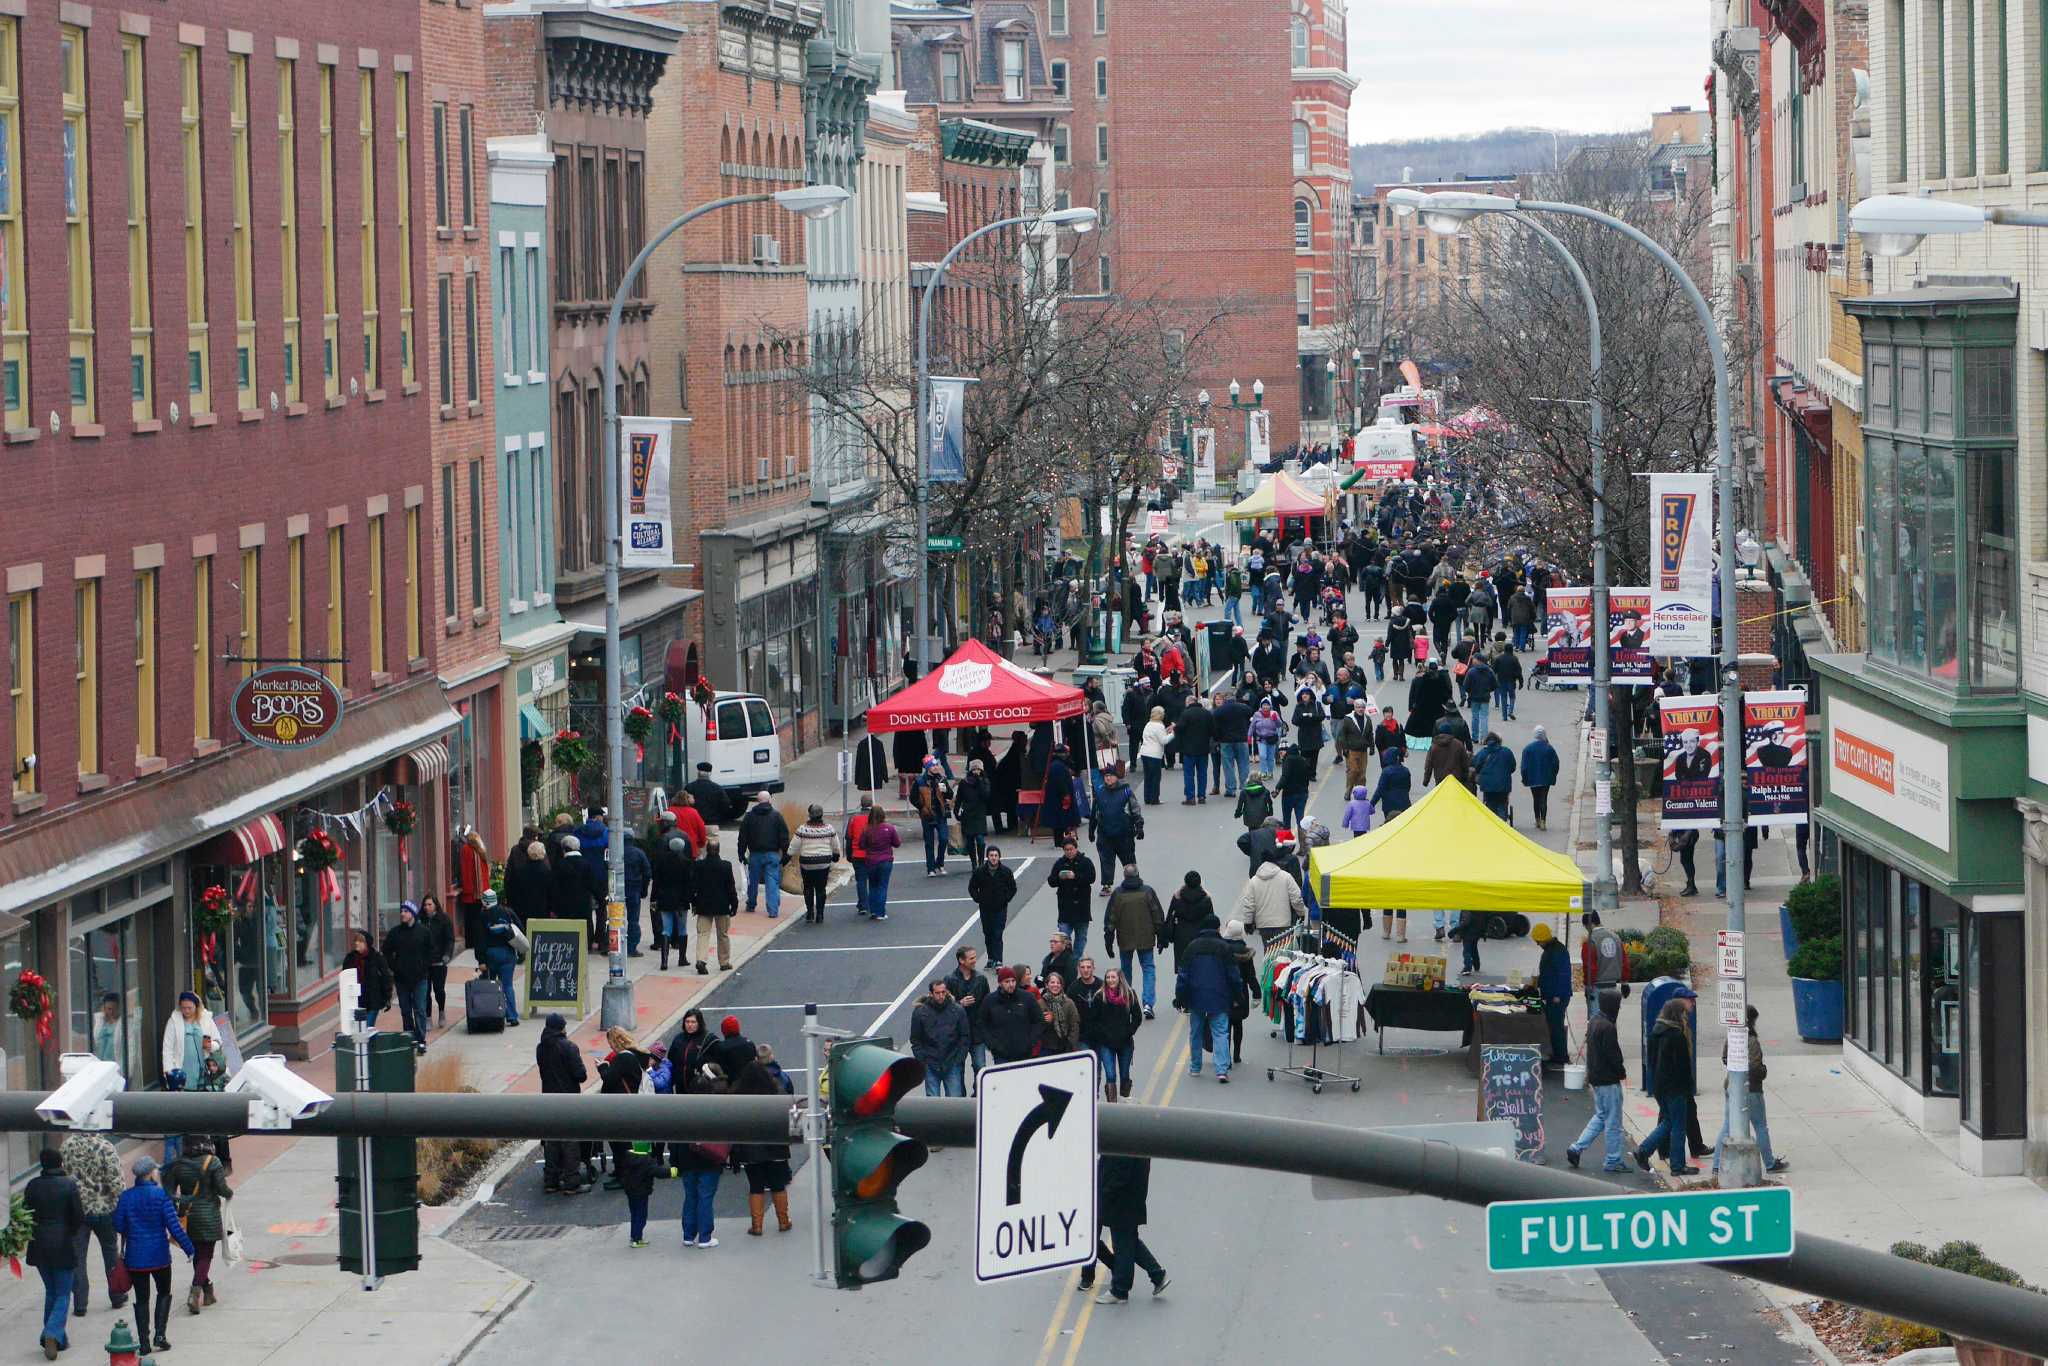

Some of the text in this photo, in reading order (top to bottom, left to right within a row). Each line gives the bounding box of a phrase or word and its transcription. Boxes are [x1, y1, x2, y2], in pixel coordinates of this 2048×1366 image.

[634, 440, 644, 489] TROY
[1665, 502, 1680, 561] TROY
[1663, 580, 1677, 589] NY
[1653, 612, 1708, 622] Rensselaer
[1653, 622, 1685, 631] Honda
[253, 680, 322, 691] Market Block
[251, 694, 324, 724] BOOKS
[932, 711, 956, 722] THE
[958, 709, 991, 721] MOST
[1835, 737, 1849, 763] TROY
[1850, 744, 1868, 772] CLOTH
[1874, 754, 1893, 785] PAPER
[1753, 770, 1799, 784] Honor
[1670, 785, 1713, 798] Honor
[1751, 785, 1771, 795] Ralph
[1772, 785, 1780, 794] J.
[1665, 798, 1718, 810] Gennaro Valenti
[534, 934, 574, 962] happy
[1725, 949, 1737, 957] ANY
[534, 953, 574, 979] holiday
[1724, 959, 1738, 968] TIME
[1727, 983, 1736, 992] NO
[1721, 992, 1742, 1000] PARKING
[1721, 1001, 1742, 1009] LOADING
[1490, 1049, 1526, 1062] Welcome
[996, 1208, 1077, 1259] ONLY
[1520, 1204, 1760, 1255] FULTON ST
